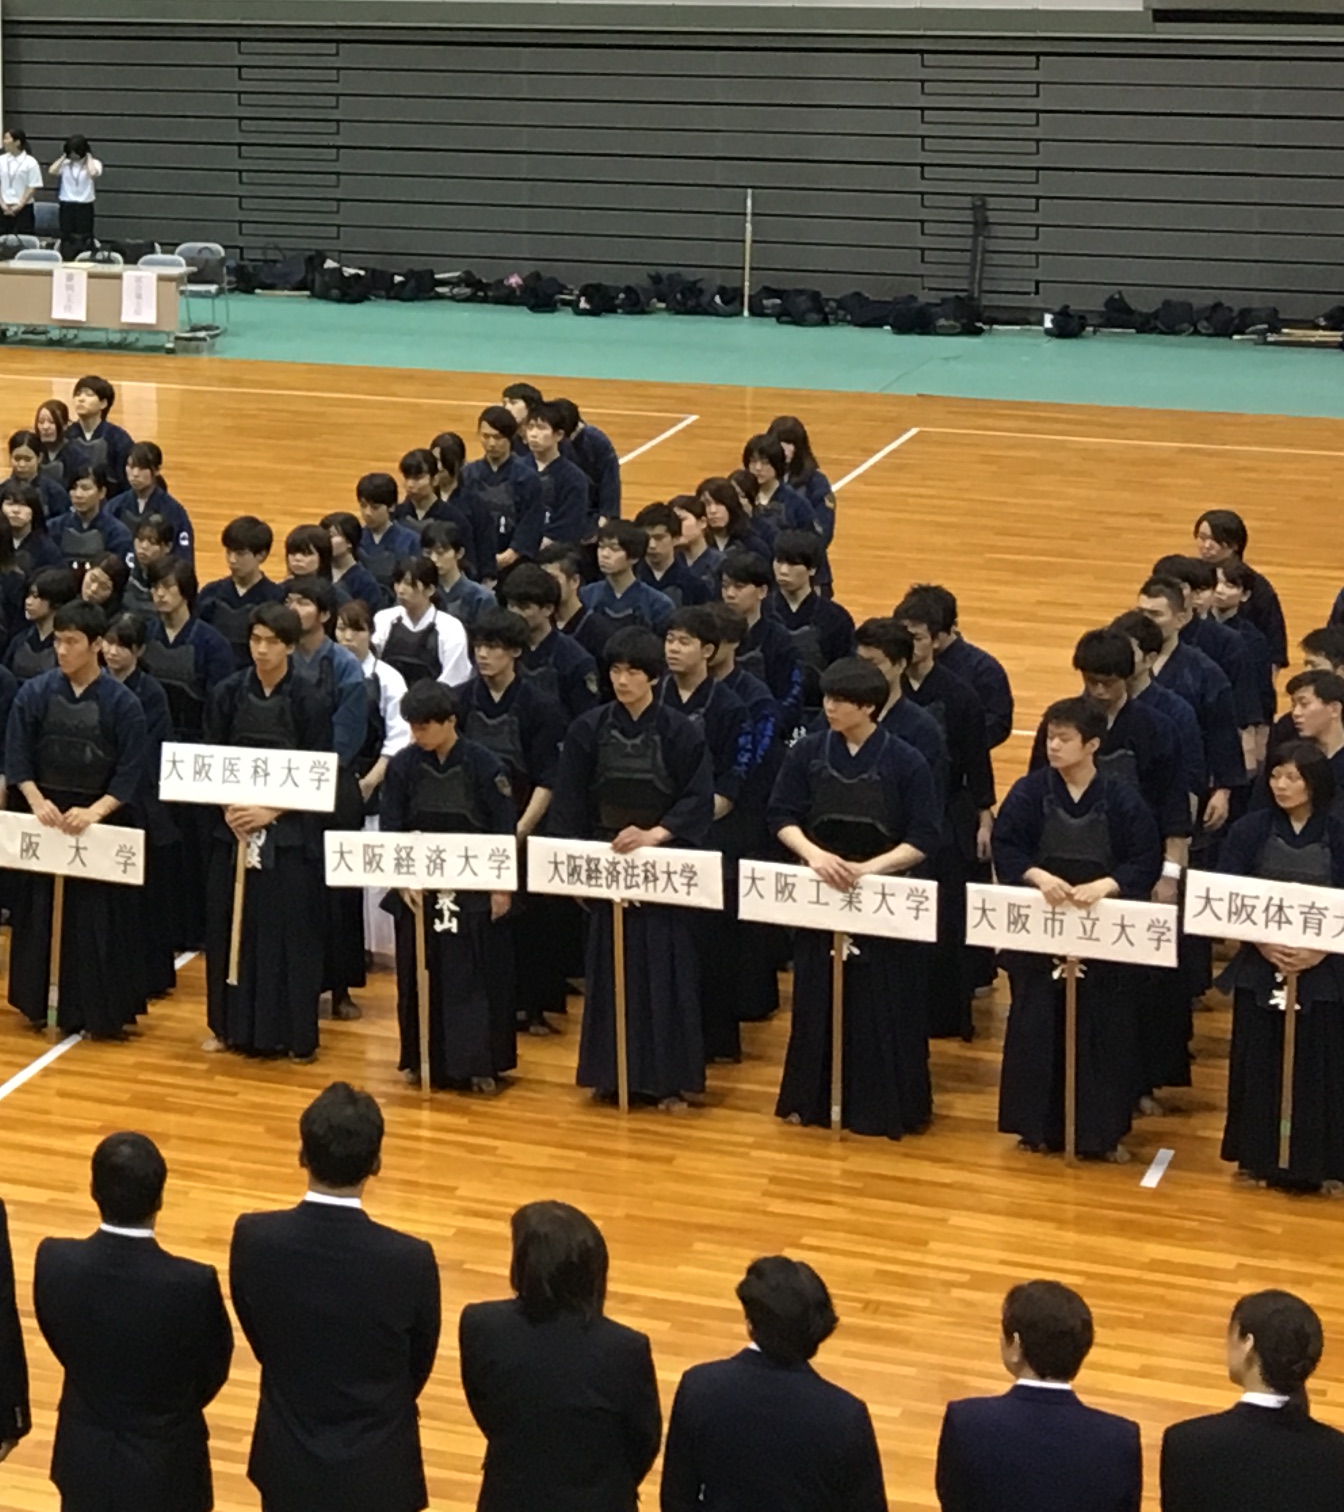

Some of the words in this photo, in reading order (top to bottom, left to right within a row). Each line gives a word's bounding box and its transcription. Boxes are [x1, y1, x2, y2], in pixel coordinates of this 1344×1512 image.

[164, 751, 332, 791] 大阪医科大学
[331, 841, 512, 880] 大阪経済大学
[547, 851, 699, 896] 大阪経済法科大学
[742, 866, 931, 921] 大阪工業大学
[972, 898, 1173, 952] 大阪市立大学
